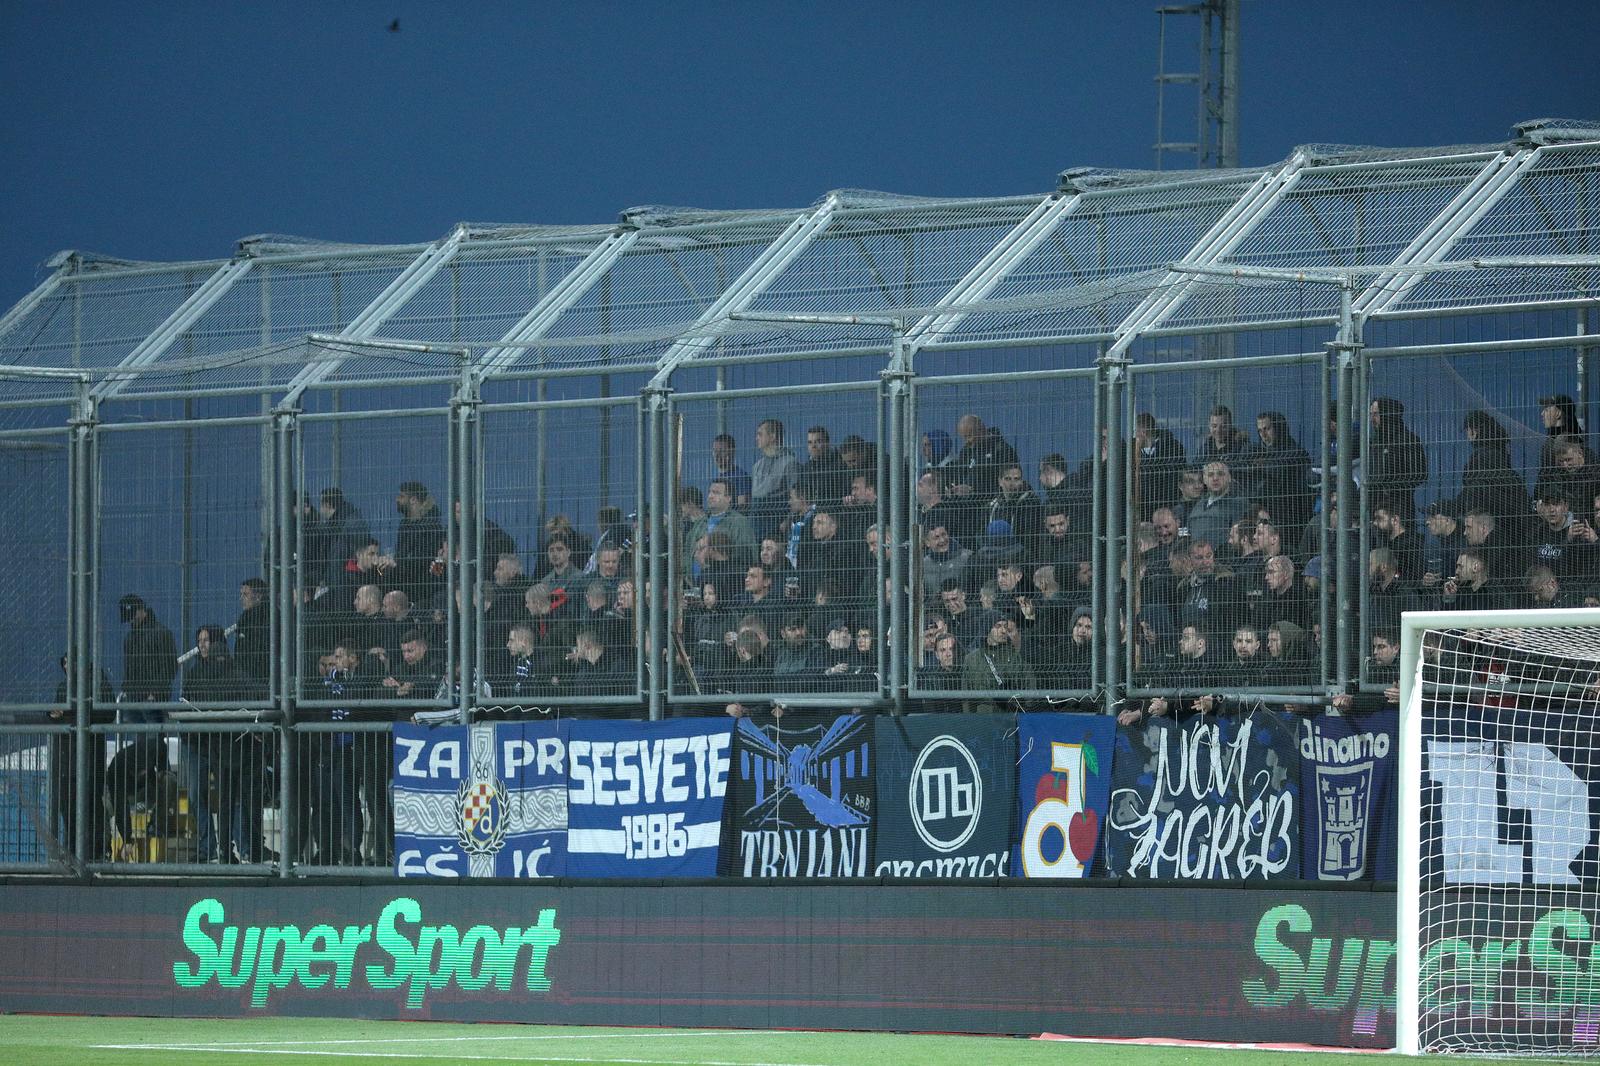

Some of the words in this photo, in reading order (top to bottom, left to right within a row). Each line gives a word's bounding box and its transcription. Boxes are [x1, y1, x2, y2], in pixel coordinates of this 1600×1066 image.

[395, 736, 461, 779] ZA
[503, 737, 566, 780] PR
[1300, 717, 1389, 763] dinamo
[475, 761, 489, 779] 86
[568, 732, 732, 806] SESVETE
[621, 812, 689, 860] 1986
[173, 897, 561, 1009] SuperSport
